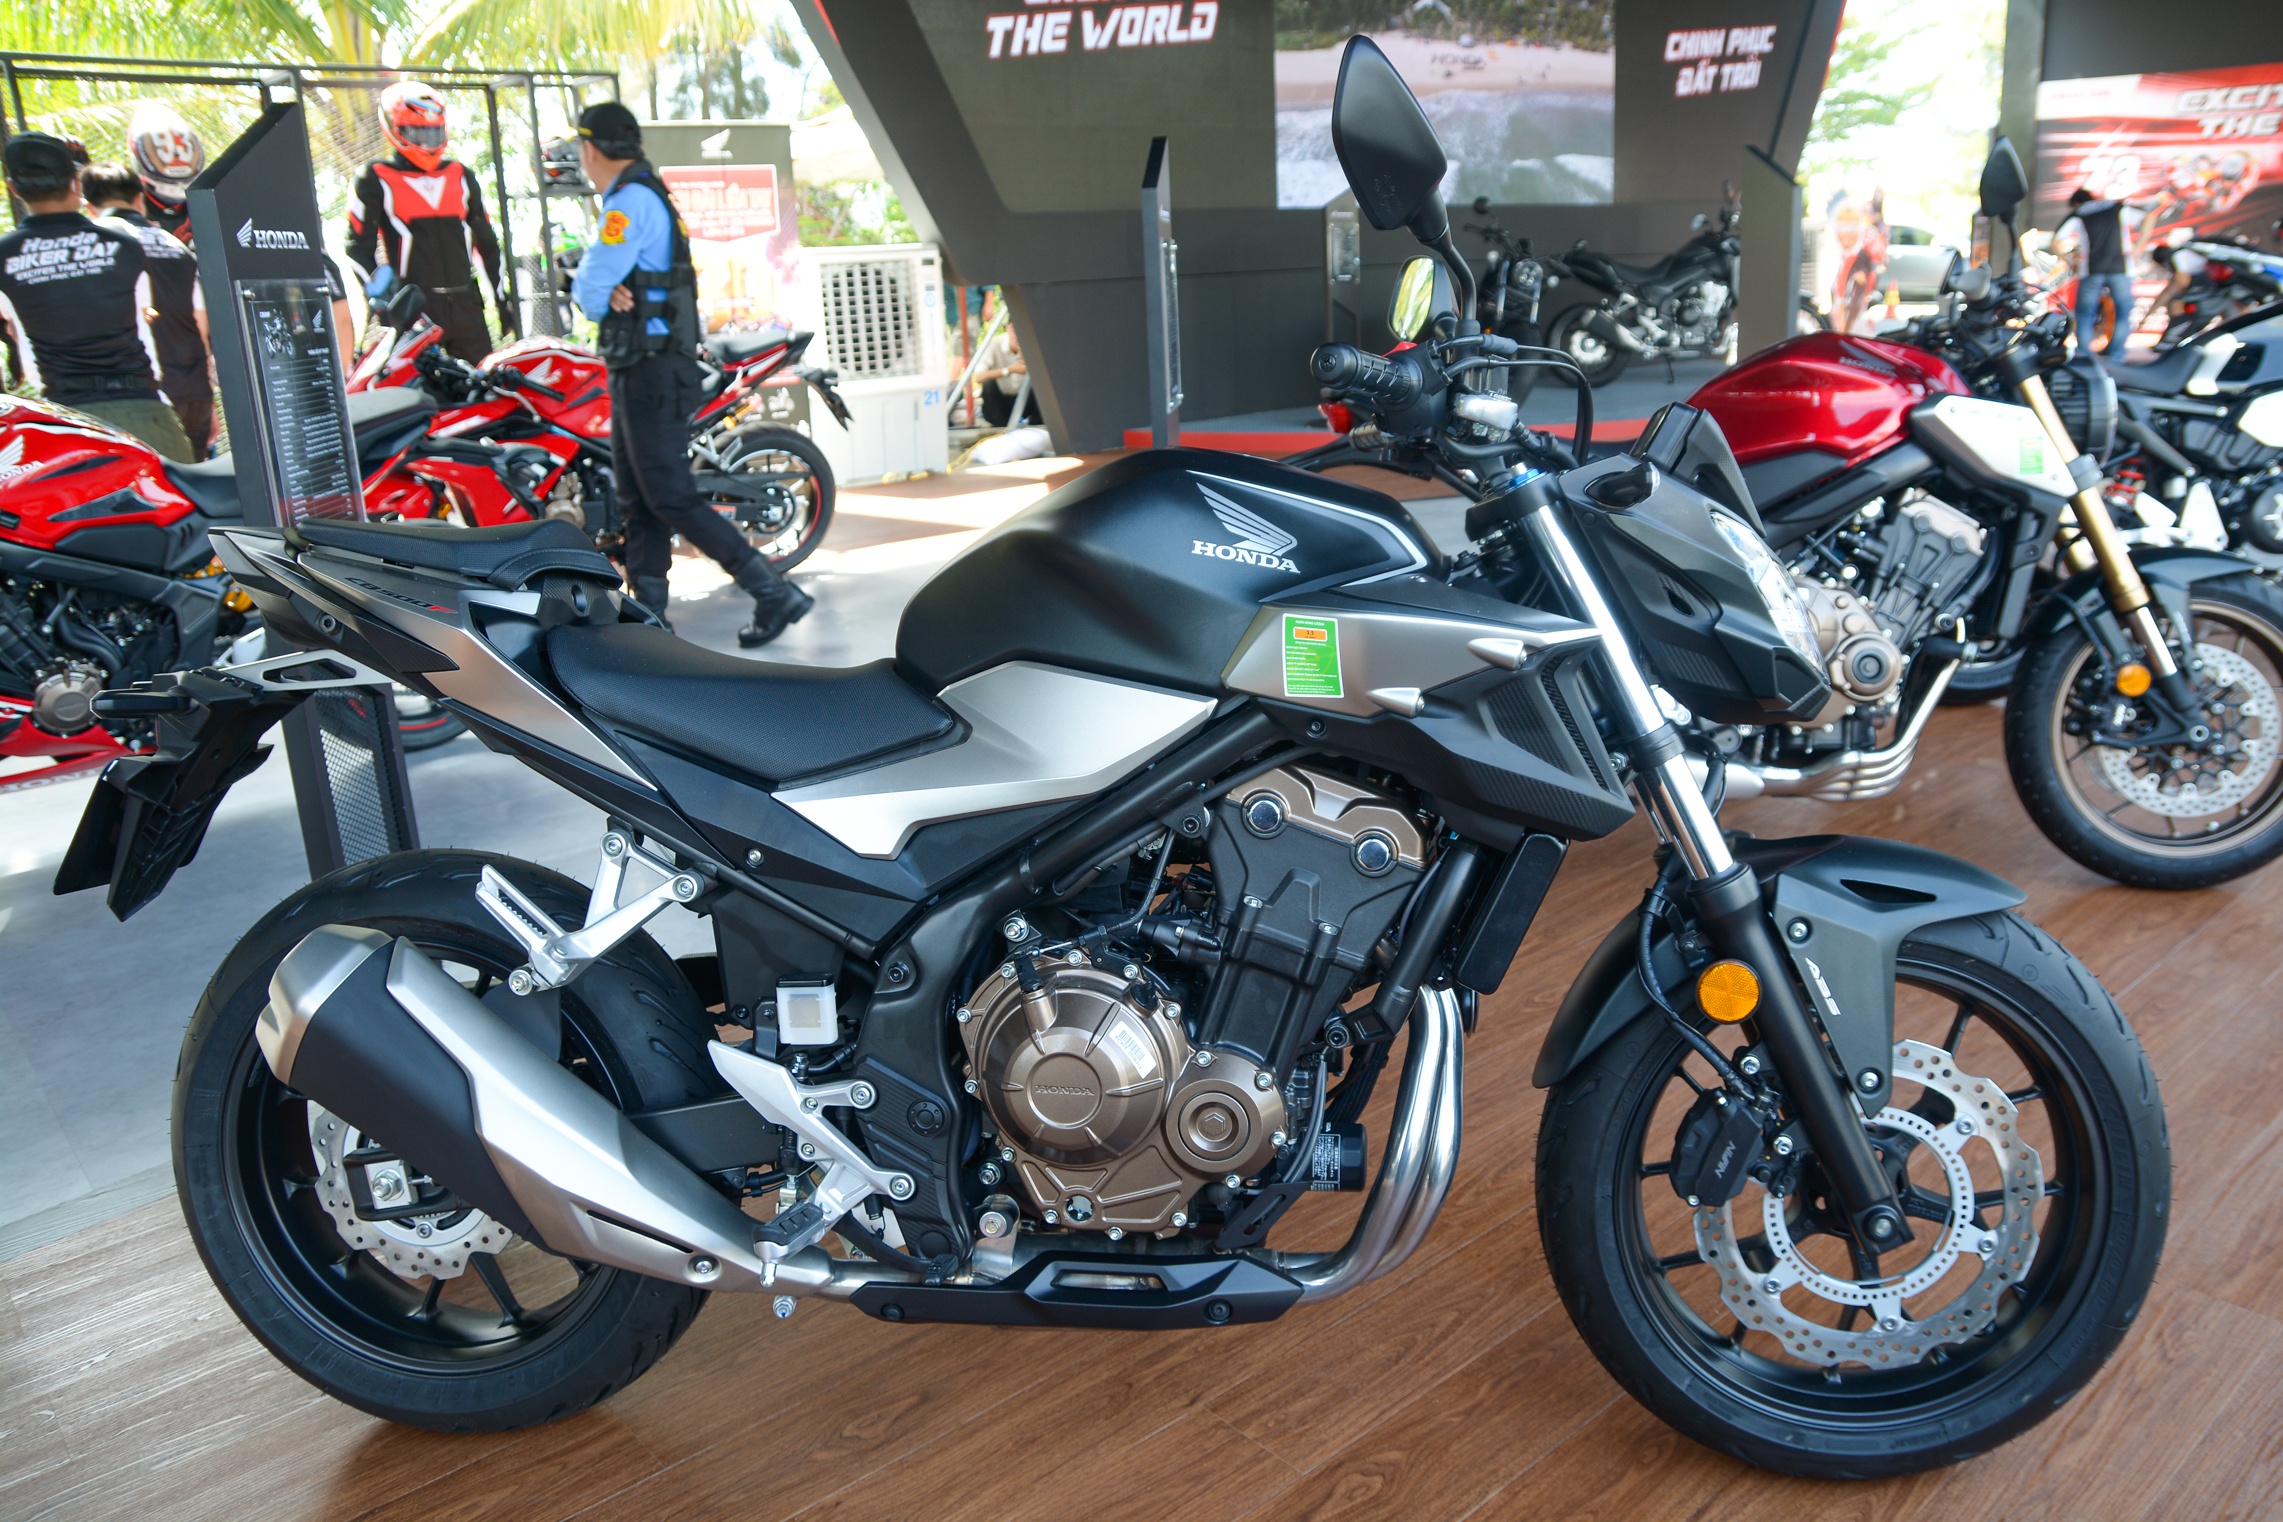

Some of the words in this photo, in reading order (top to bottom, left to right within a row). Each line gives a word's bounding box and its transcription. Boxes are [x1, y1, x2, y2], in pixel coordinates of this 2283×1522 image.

[987, 11, 1072, 58] THE
[1081, 1, 1219, 50] WORLD
[1664, 28, 1726, 62] CHINH
[2199, 111, 2281, 138] THE
[21, 231, 99, 254] Honda
[253, 229, 311, 250] HONDA
[5, 248, 70, 275] BIKER
[73, 240, 121, 261] DAY
[923, 390, 941, 405] 21
[0, 460, 45, 482] ONDA
[1191, 539, 1301, 574] HONDA
[1805, 957, 1842, 1016] ABS
[1035, 1084, 1095, 1096] HONDA
